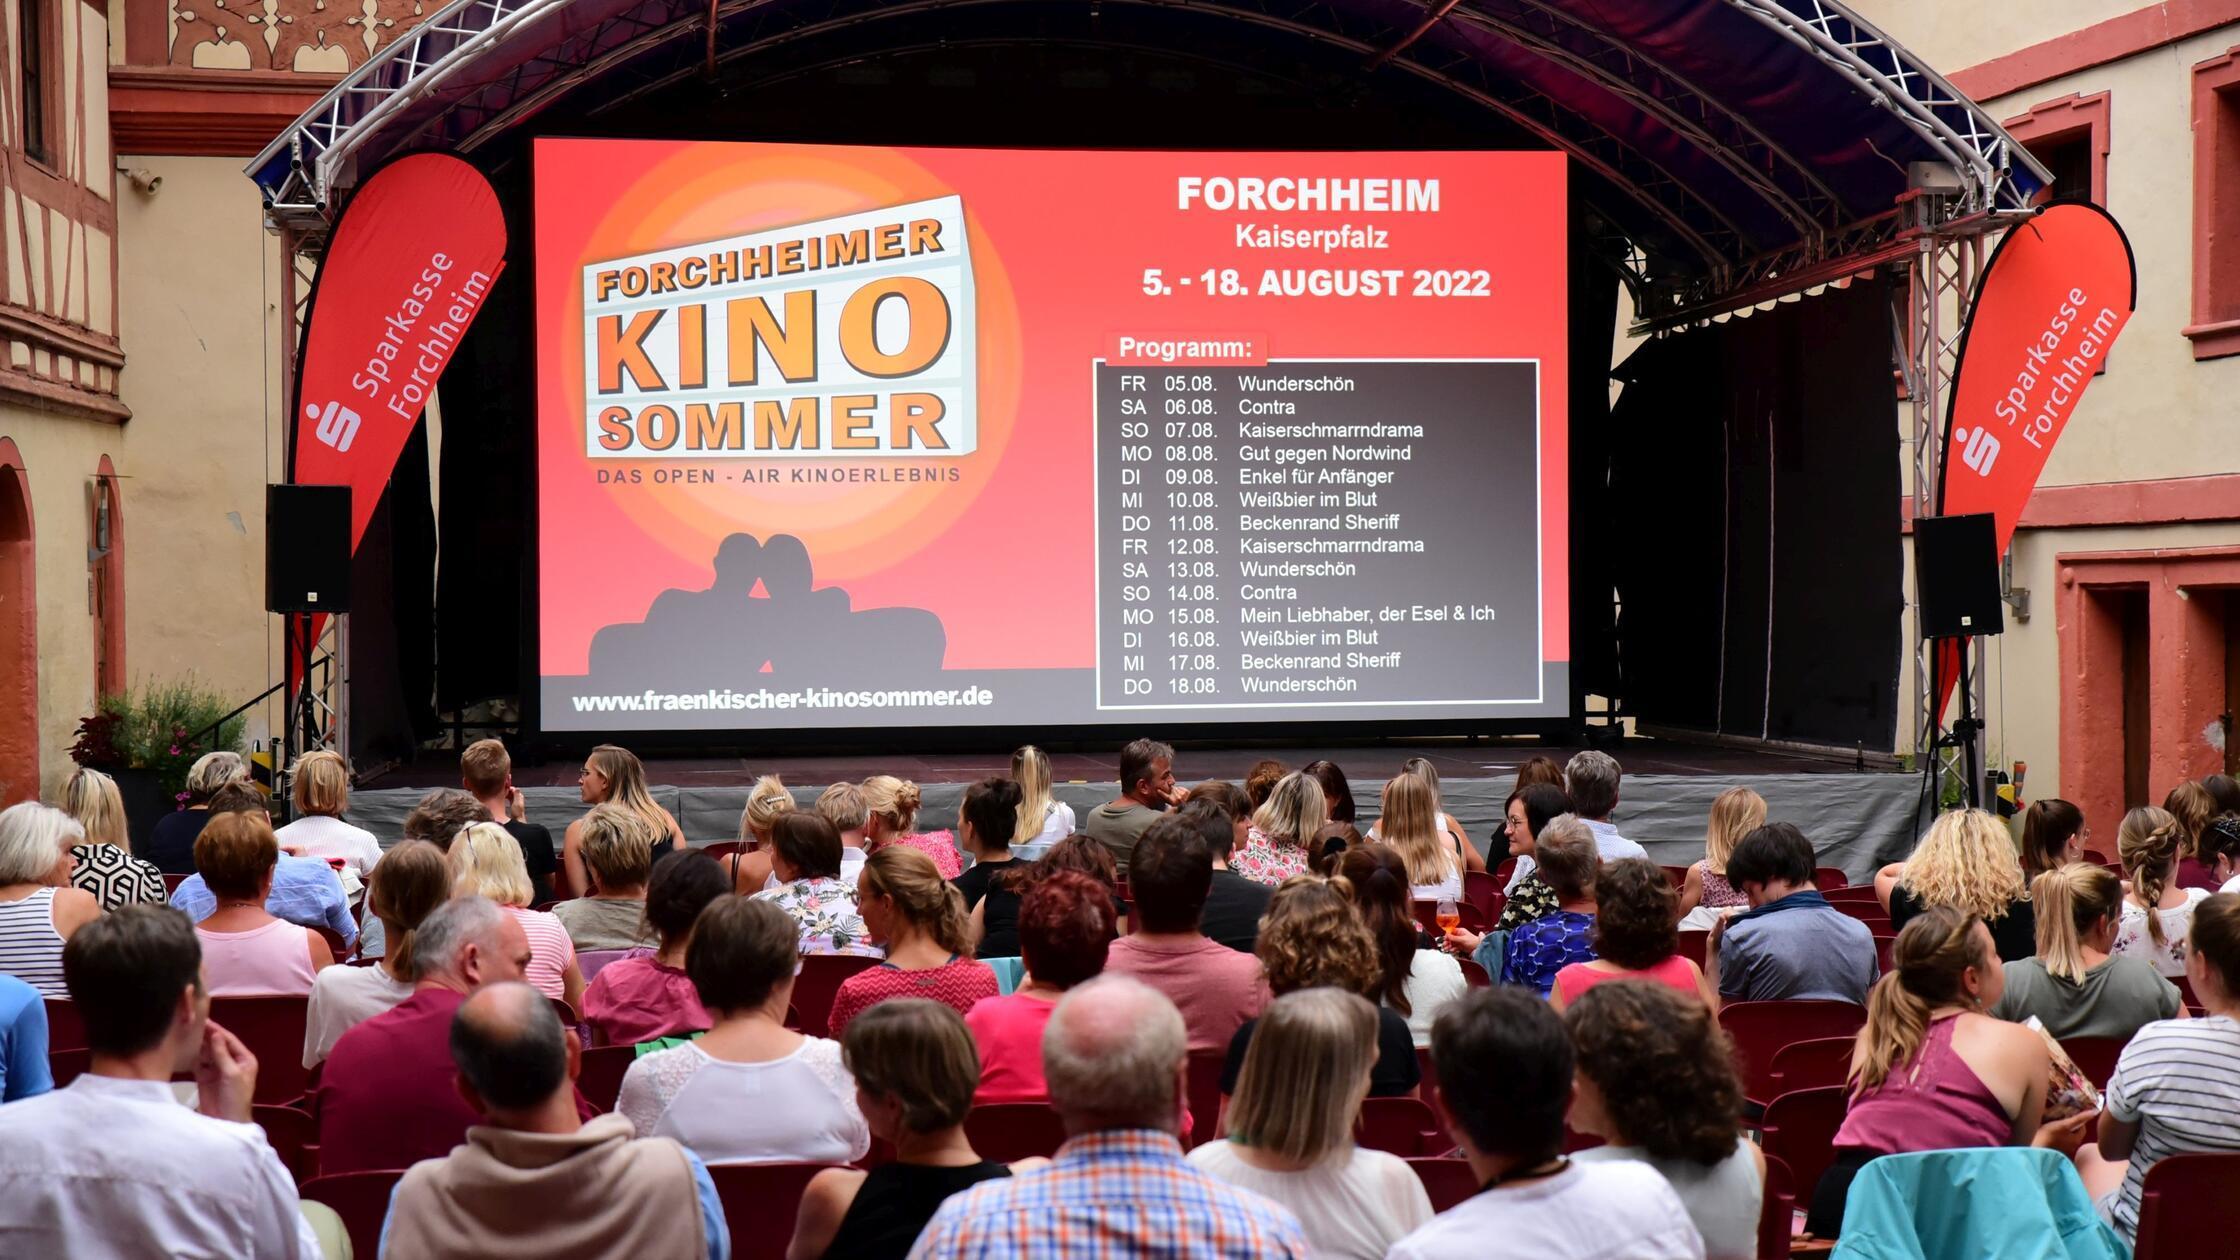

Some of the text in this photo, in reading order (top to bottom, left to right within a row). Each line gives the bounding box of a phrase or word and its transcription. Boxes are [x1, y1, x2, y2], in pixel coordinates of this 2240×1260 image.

[1177, 176, 1441, 212] FORCHHEIM
[1235, 223, 1390, 254] Kaiserpfalz
[596, 217, 945, 303] FORCHHEIMER
[1142, 268, 1172, 296] 5.
[1200, 268, 1249, 297] 18.
[1257, 269, 1404, 297] AUGUST
[1412, 269, 1491, 297] 2022
[352, 251, 454, 399] Sparkasse
[596, 275, 953, 395] KINO
[387, 269, 491, 421] Forchheim
[1119, 336, 1253, 362] Programm:
[1995, 286, 2088, 426] Sparkasse
[1121, 375, 1355, 392] FR 05.08. Wunderschön
[2022, 305, 2119, 449] Forchheim
[1120, 398, 1296, 415] SA 06.08. Contra
[597, 391, 951, 451] SOMMER
[1121, 421, 1424, 439] SO 07.08. Kaiserschmarrndrama
[1121, 444, 1411, 465] MO 08.08. Gut gegen Nordwind
[596, 468, 643, 484] DAS
[653, 468, 715, 484] OPEN
[741, 468, 781, 484] AIR
[790, 467, 961, 484] KINOERLEBNIS
[1121, 467, 1395, 488] DI 09.08. Enkel für Anfänger
[1122, 490, 1378, 509] MI 10.08. Weißbier im Blut
[1122, 513, 1400, 532] DO 11.08. Beckenrand Sheriff
[1122, 536, 1425, 555] FR 12.08. Kaiserschmarrndrama
[1122, 560, 1356, 578] SA 13.08. Wunderschön
[1122, 584, 1298, 602] SO 14.08. Contra
[1123, 604, 1495, 625] MO 15.08. Mein Liebhaber, der Esel & Ich
[1123, 628, 1379, 649] DI 16.08. Weißbier im Blut
[1123, 651, 1402, 672] MI 17.08. Beckenrand Sheriff
[1124, 675, 1357, 695] DO 18.08. Wunderschön
[572, 685, 994, 712] www.fraenkischer-kinosommer.de
